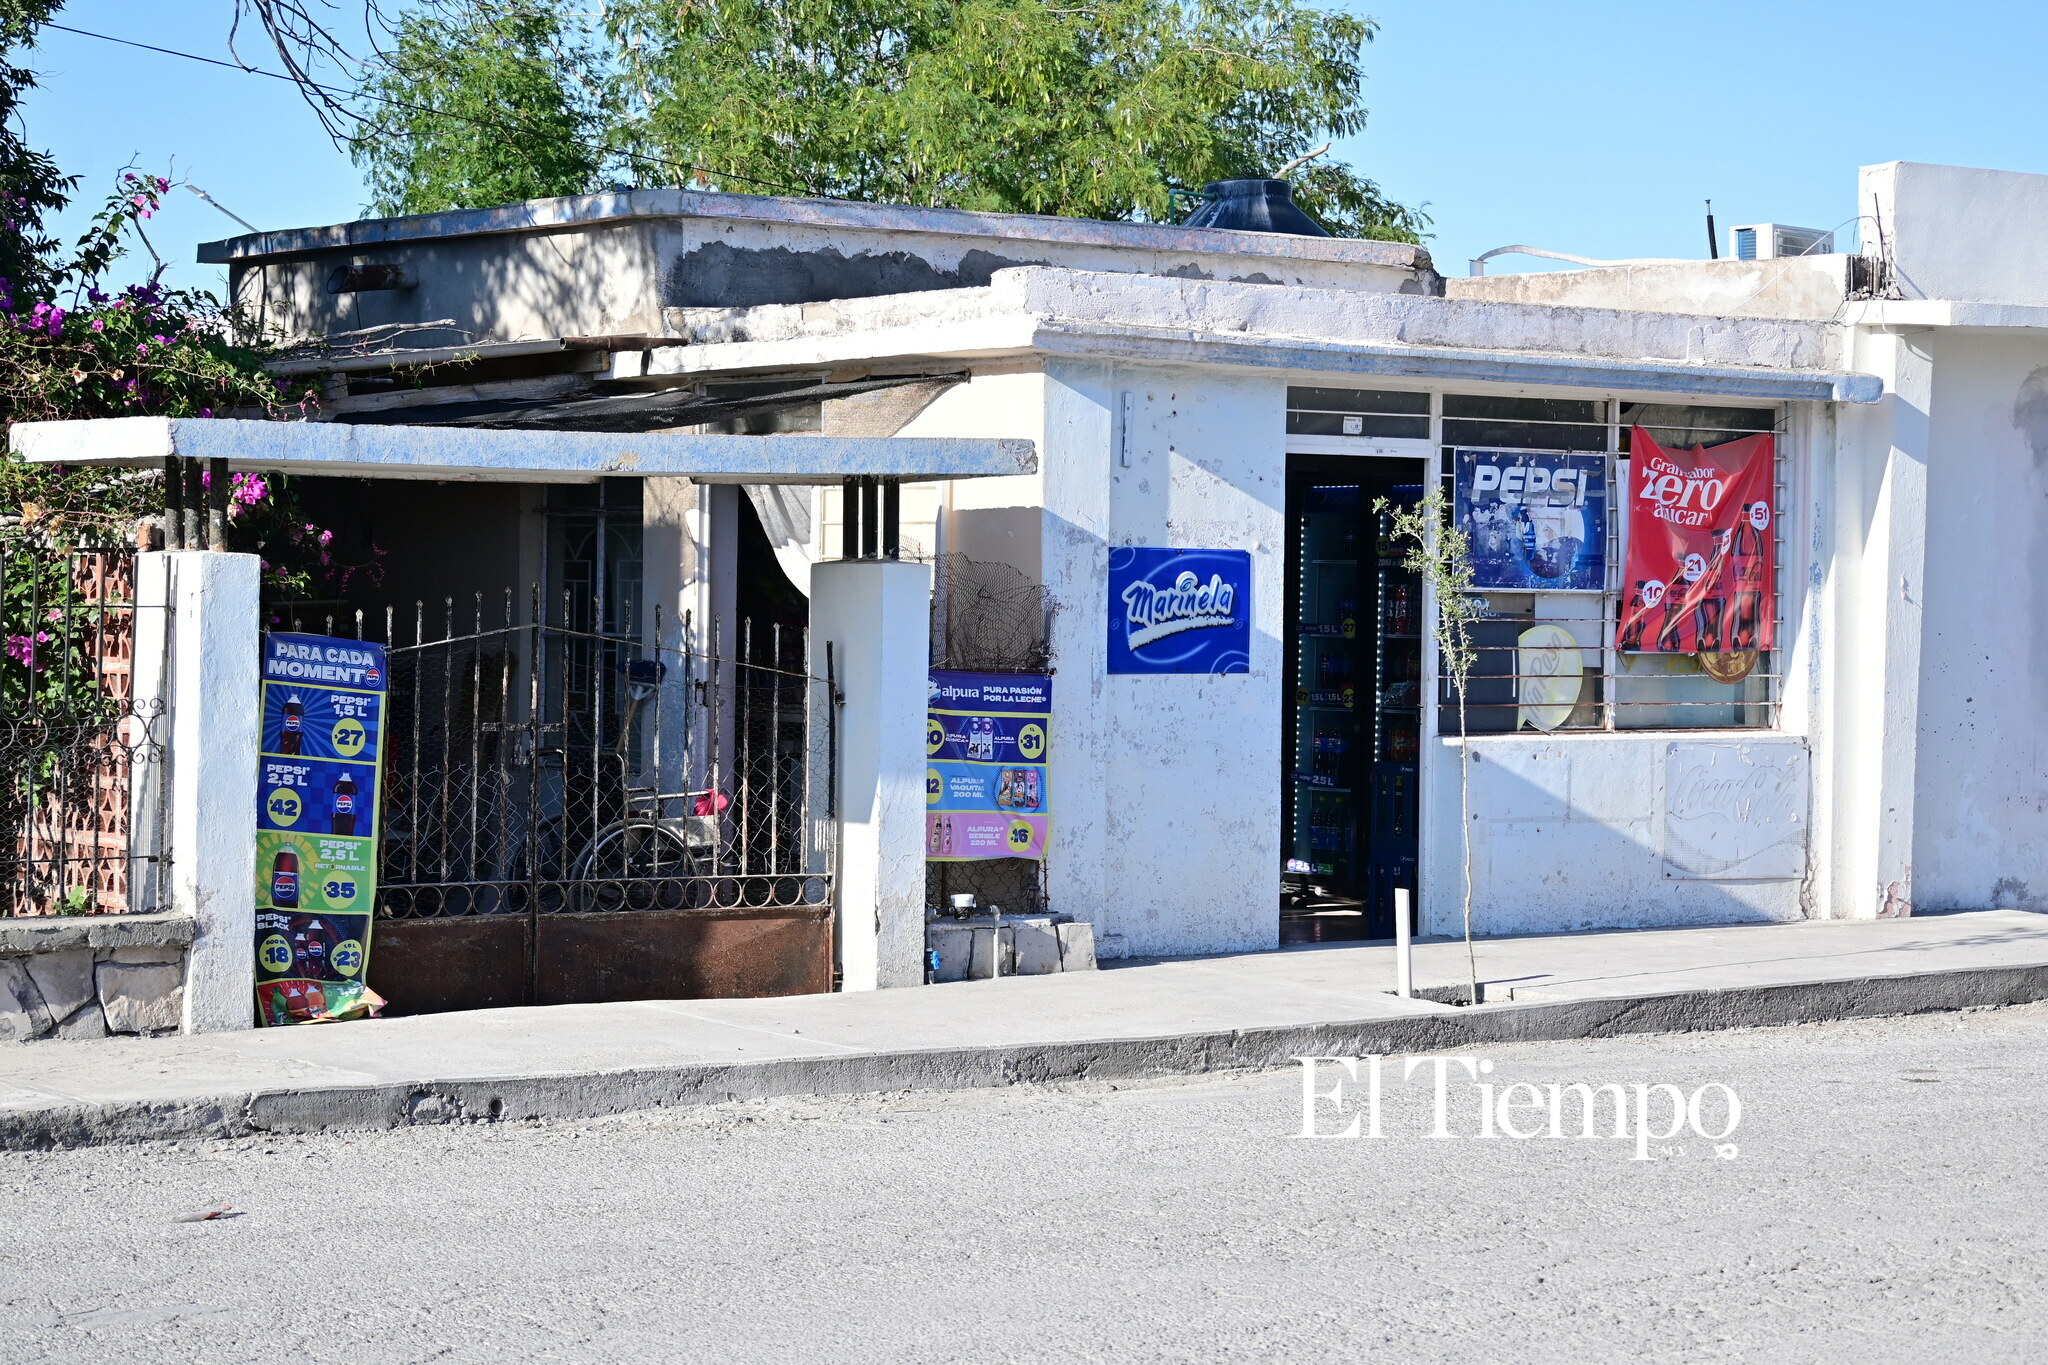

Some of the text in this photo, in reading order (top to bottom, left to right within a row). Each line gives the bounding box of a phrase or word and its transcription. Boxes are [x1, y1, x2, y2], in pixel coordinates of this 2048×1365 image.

[1470, 464, 1588, 508] PEPSI
[1122, 572, 1233, 626] Marinela
[276, 642, 375, 667] PARA CADA
[942, 685, 980, 700] alpura
[983, 686, 1042, 695] PURA PASIÓN
[333, 704, 367, 717] 1,5 L
[267, 773, 308, 786] 2,5 L
[320, 848, 360, 862] 2,5 L
[315, 863, 366, 871] RETRNABLE
[257, 922, 289, 931] BLACK
